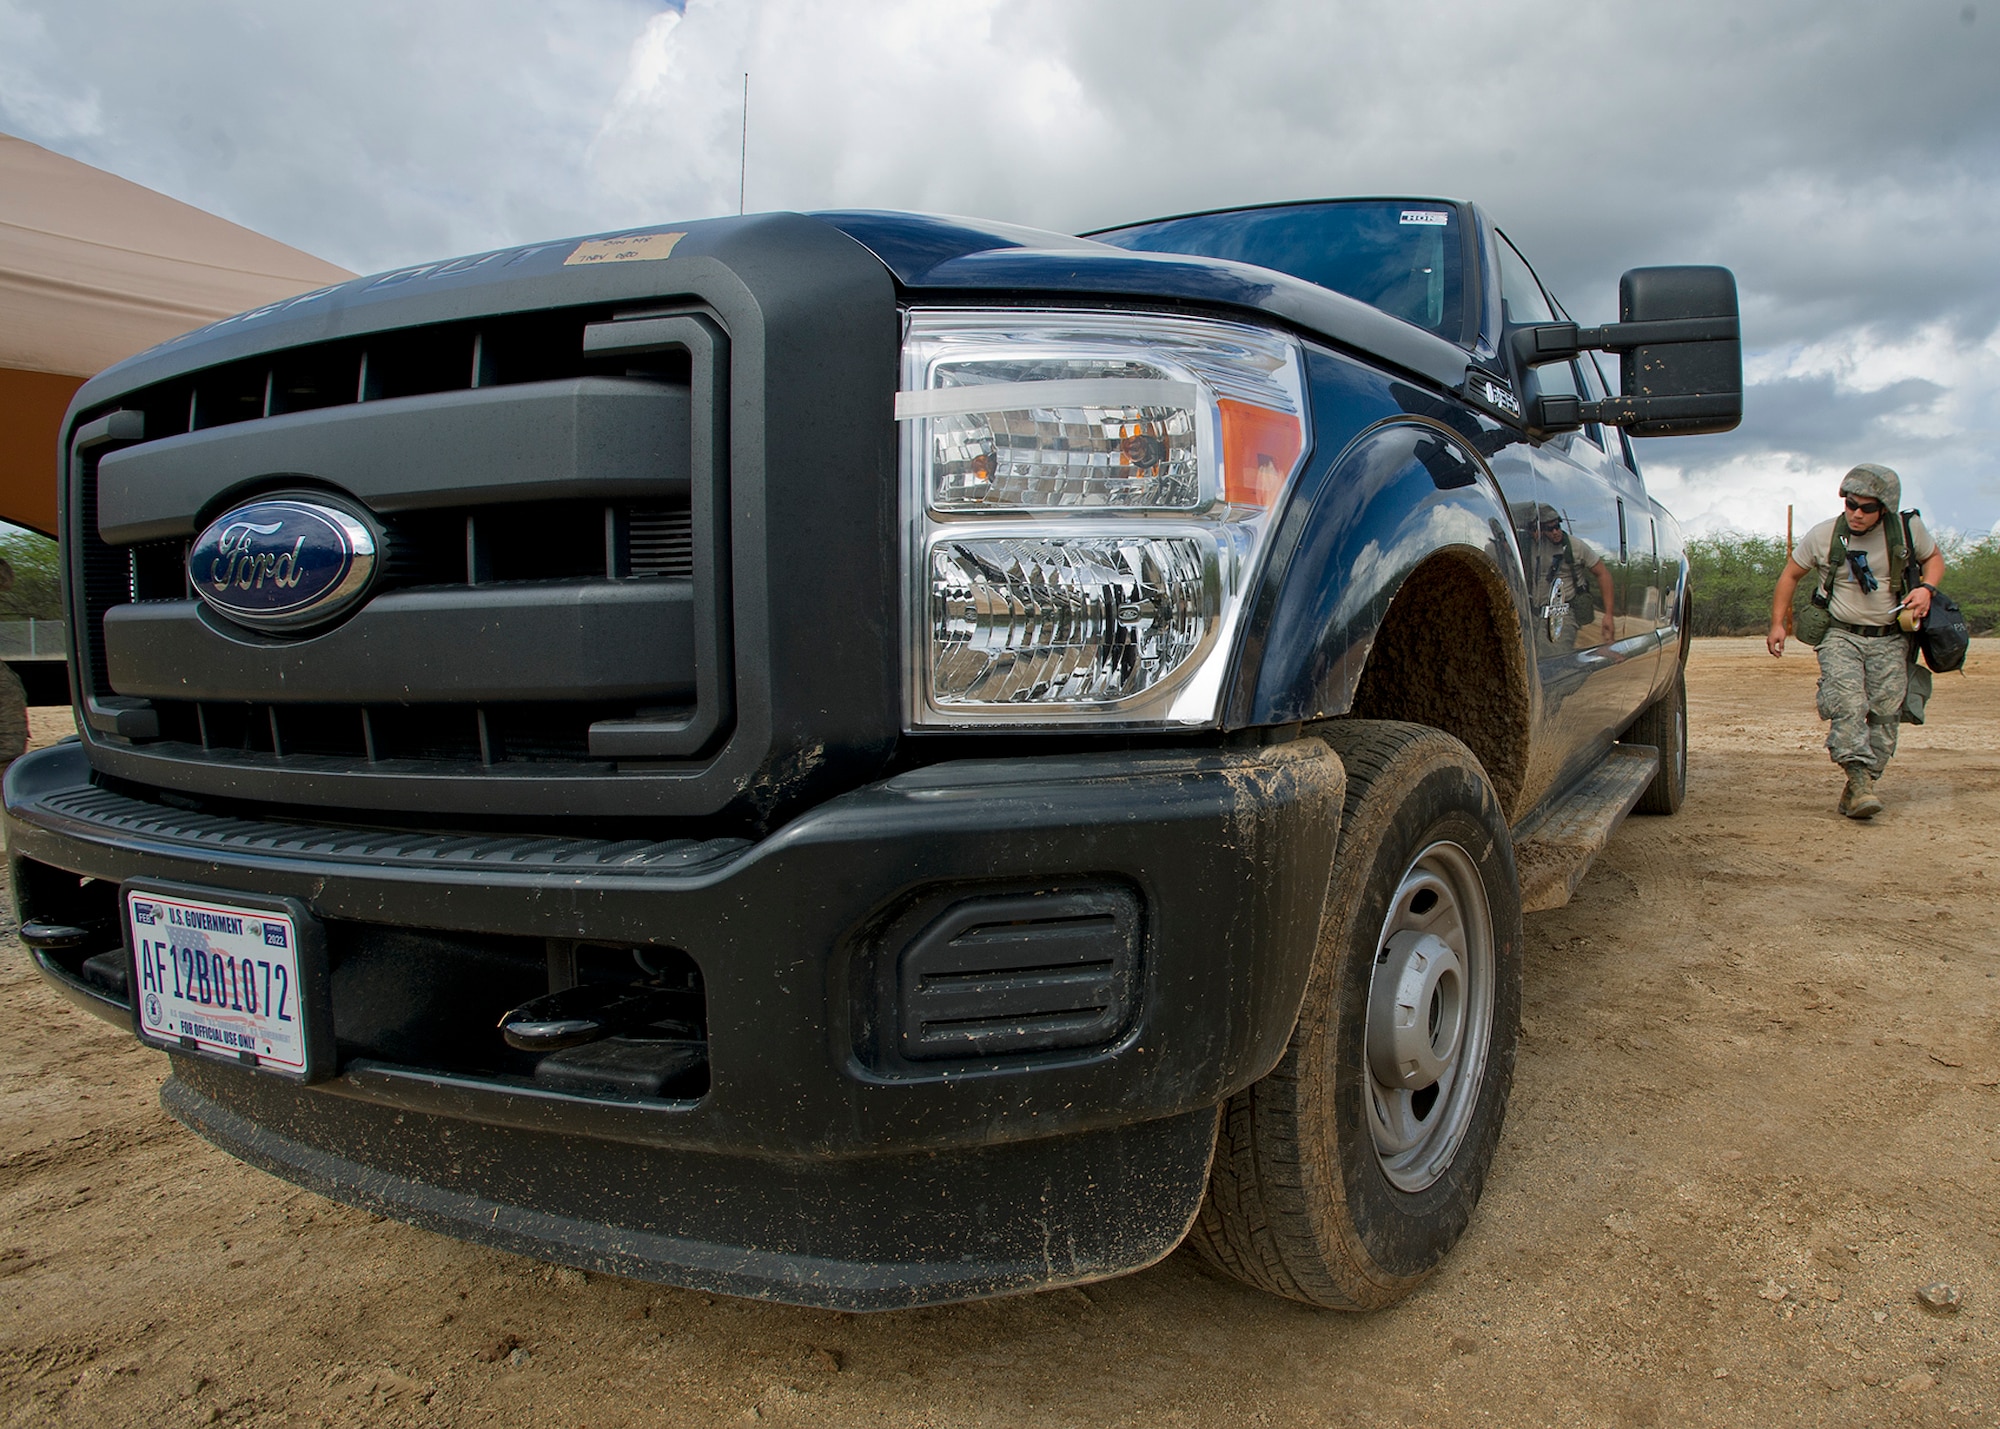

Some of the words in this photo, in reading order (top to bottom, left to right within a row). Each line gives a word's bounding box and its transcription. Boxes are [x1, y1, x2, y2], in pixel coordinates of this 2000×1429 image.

[211, 521, 306, 592] Ford
[168, 907, 185, 926] U.S.
[185, 910, 243, 935] GOVERNMENT
[267, 933, 285, 946] 2022
[142, 938, 292, 1022] AF12B01072
[181, 1020, 194, 1035] FOR
[194, 1023, 223, 1043] OFFICIAL
[223, 1030, 238, 1046] USE
[238, 1034, 256, 1049] ONLY
